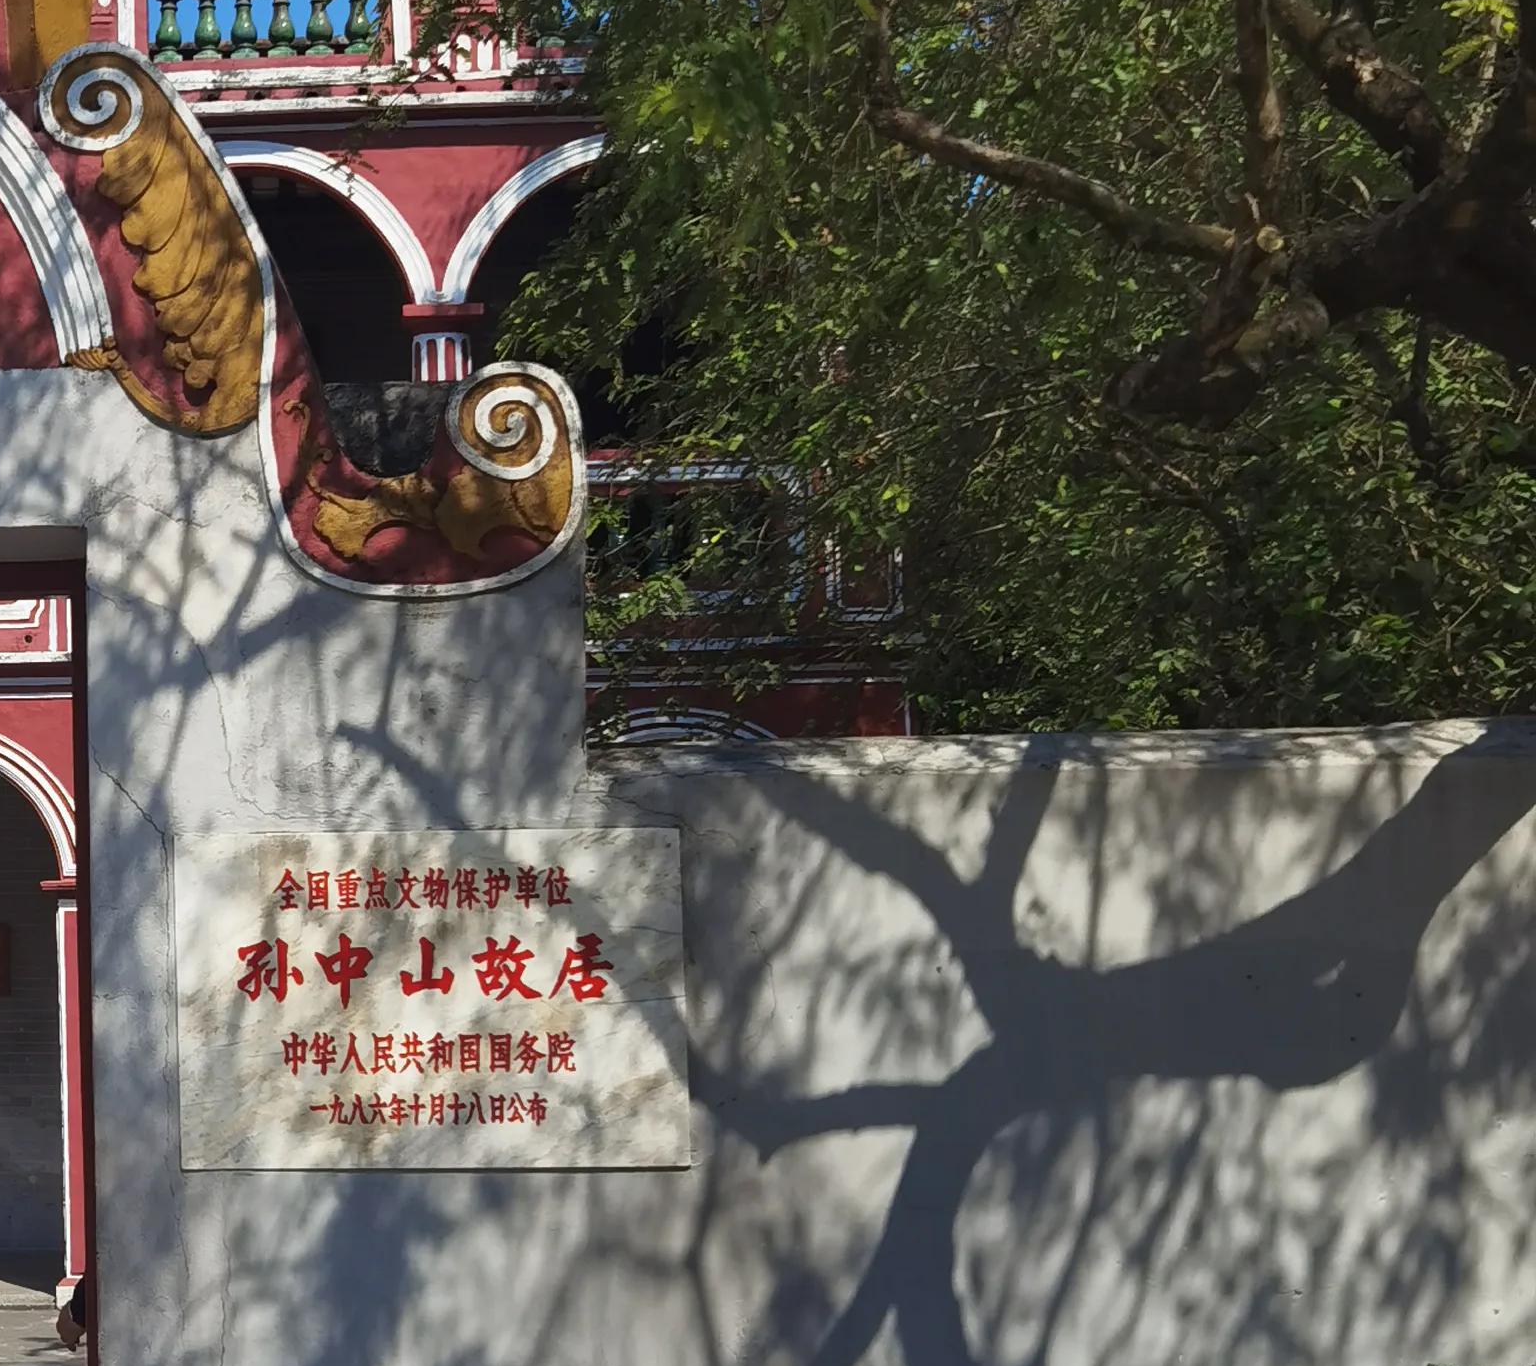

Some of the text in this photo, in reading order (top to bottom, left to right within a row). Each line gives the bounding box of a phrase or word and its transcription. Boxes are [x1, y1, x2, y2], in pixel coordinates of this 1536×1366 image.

[273, 865, 573, 911] 全国重点文物保护单位
[237, 932, 616, 1010] 孙中山故居
[282, 1031, 577, 1076] 中华人民共和国国务院
[309, 1091, 548, 1126] 一九八六年十月十八日公布
